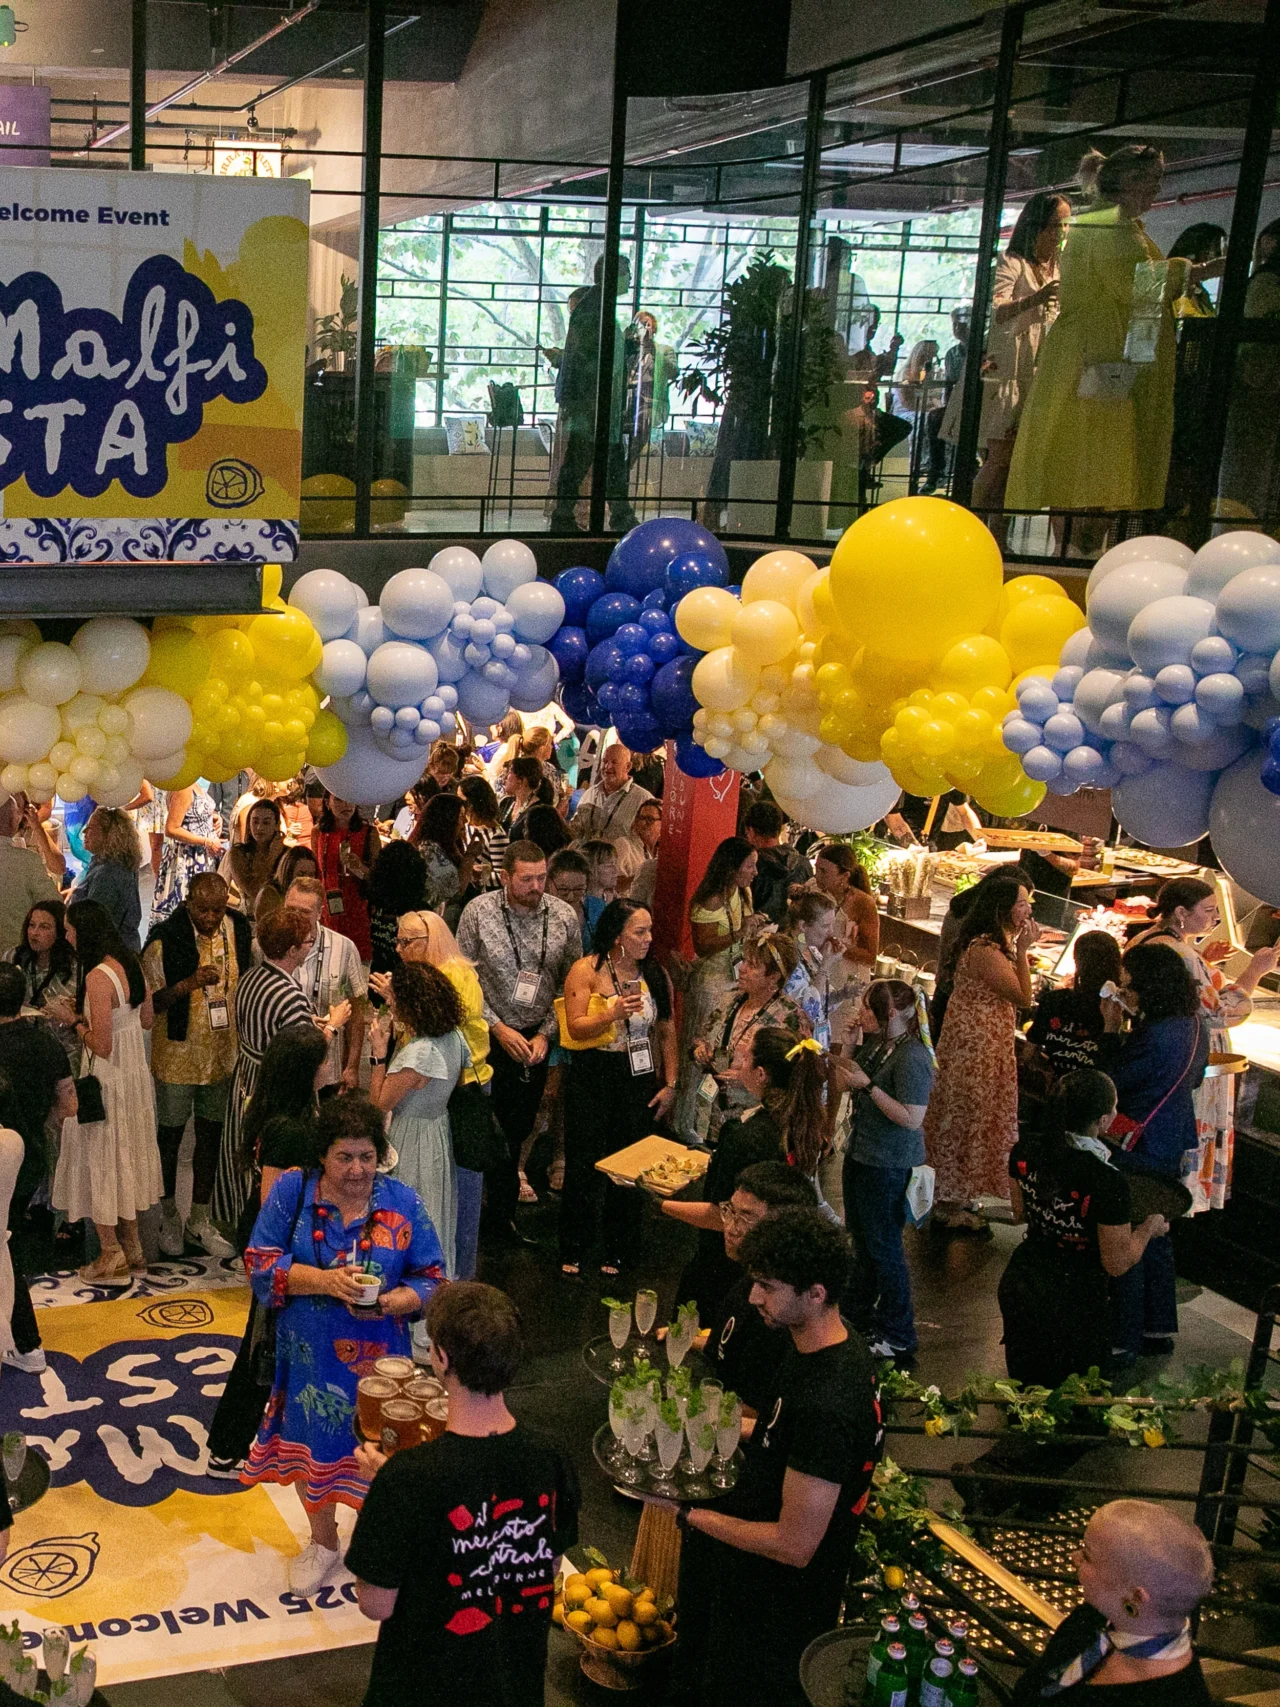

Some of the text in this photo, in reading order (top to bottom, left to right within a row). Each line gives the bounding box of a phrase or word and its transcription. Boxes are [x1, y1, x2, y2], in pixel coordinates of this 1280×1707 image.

[98, 206, 170, 226] Event
[1052, 1050, 1095, 1066] centra
[475, 1501, 487, 1528] il
